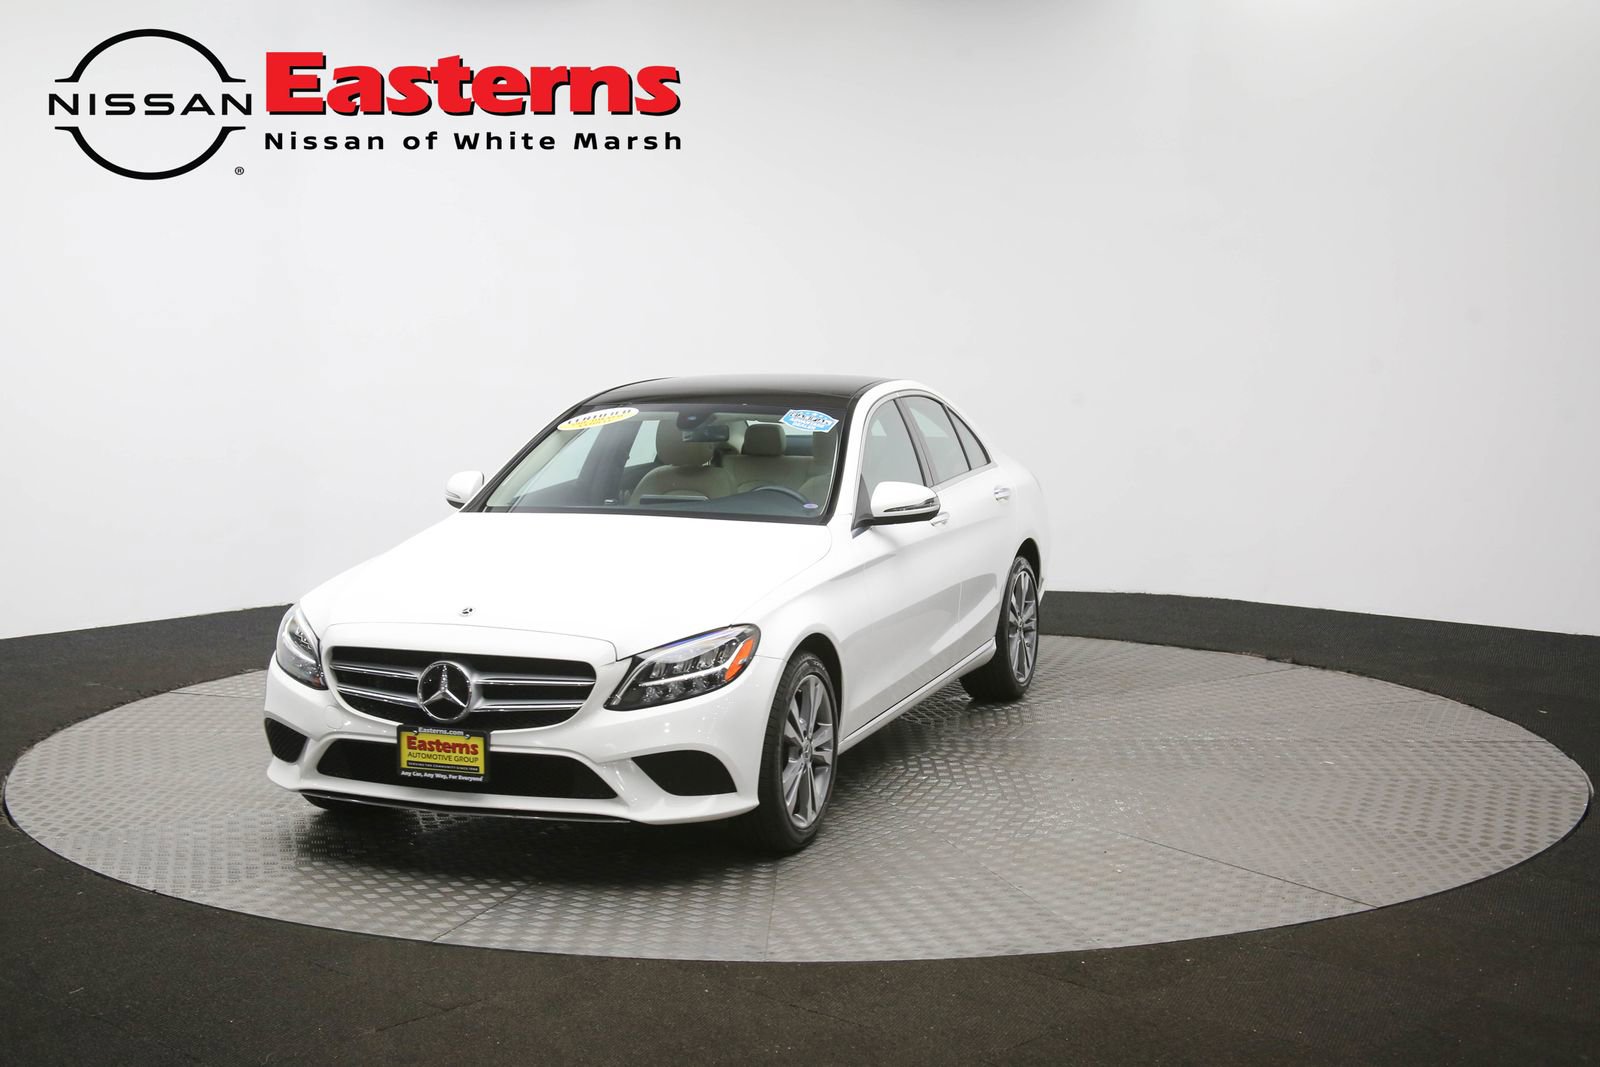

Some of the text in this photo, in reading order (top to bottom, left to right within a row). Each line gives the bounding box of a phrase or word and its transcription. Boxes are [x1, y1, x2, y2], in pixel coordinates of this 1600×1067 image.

[418, 727, 464, 736] Easterns.com
[406, 736, 479, 755] Easterns
[407, 752, 479, 764] AUTOMOTIVE GROUP
